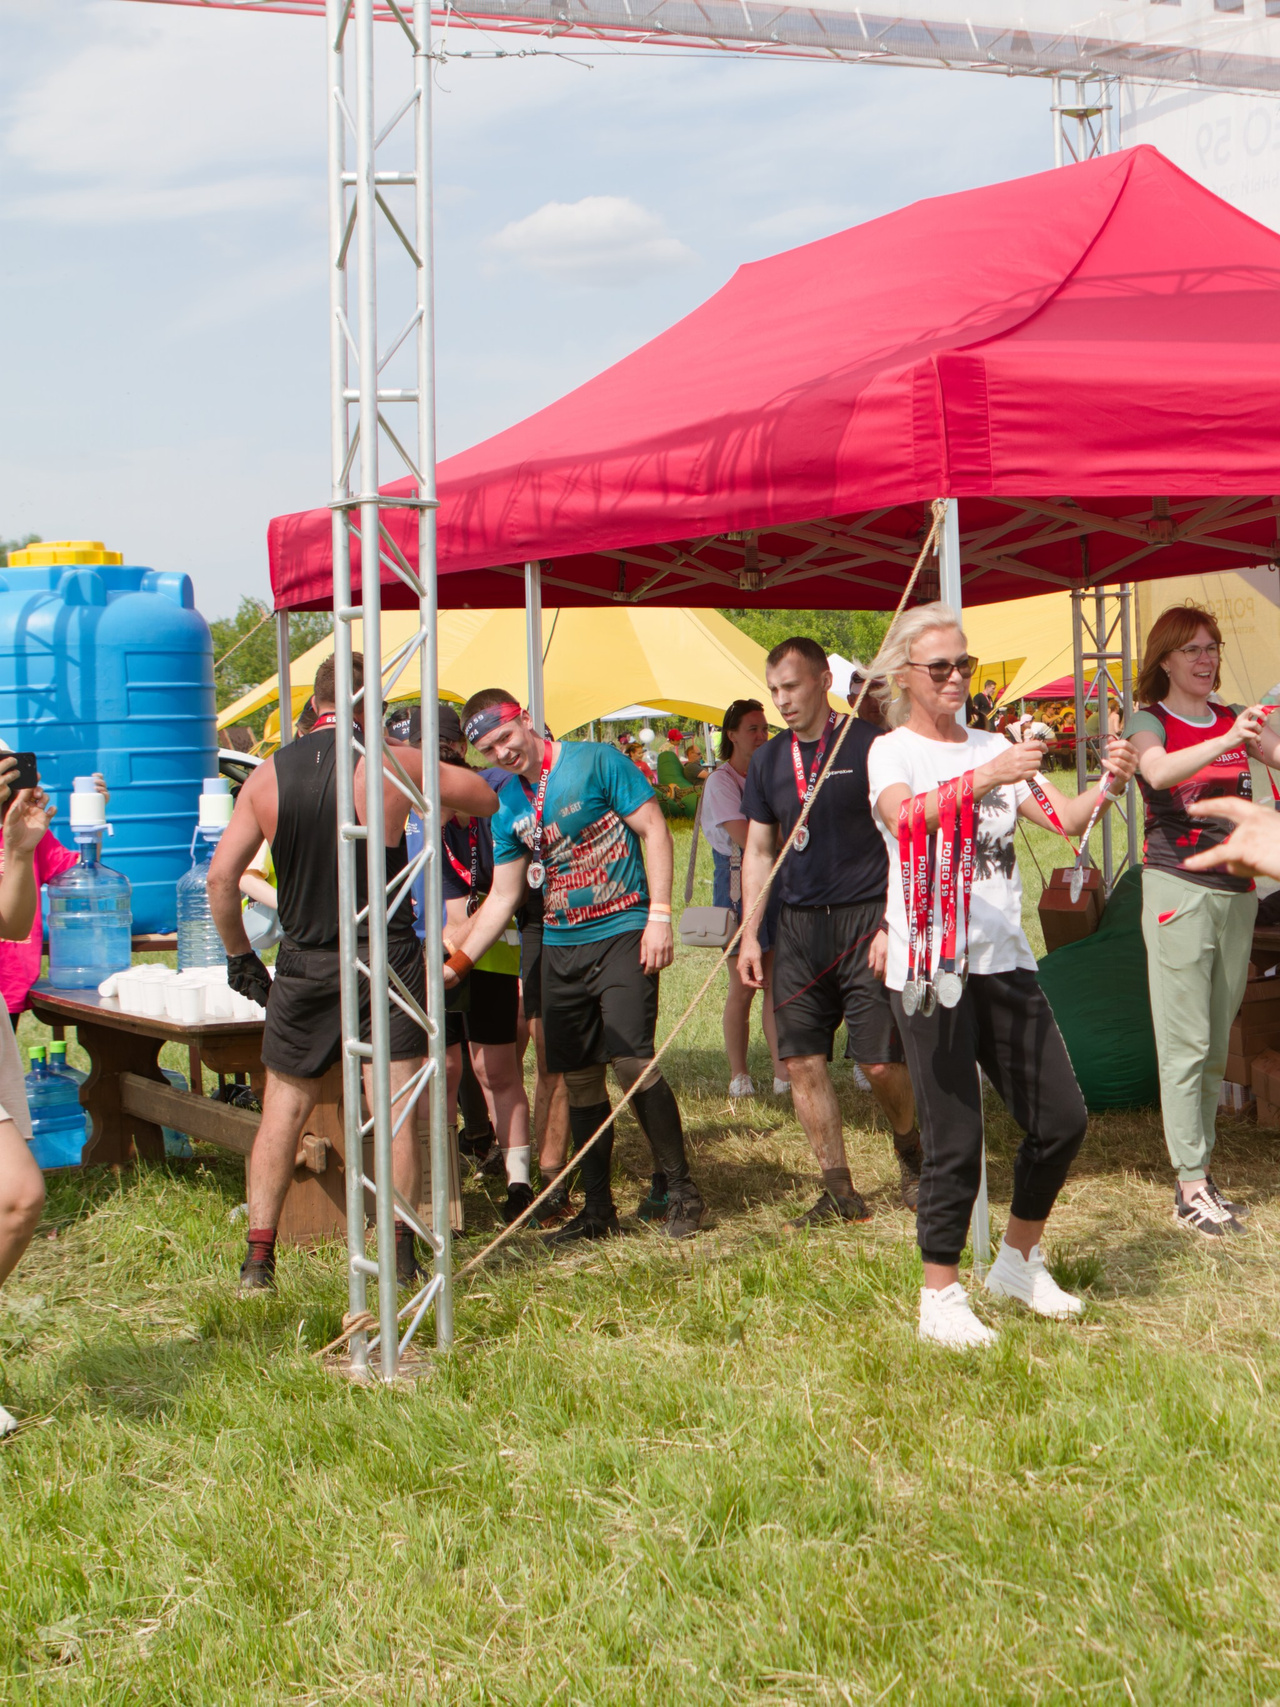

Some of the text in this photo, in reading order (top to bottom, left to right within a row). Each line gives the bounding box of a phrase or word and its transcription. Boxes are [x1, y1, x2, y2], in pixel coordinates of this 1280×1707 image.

[535, 769, 549, 799] РОДЕО
[1042, 801, 1055, 816] 59
[917, 855, 928, 895] РОДЕО
[942, 841, 953, 881] РОДЕО
[963, 838, 973, 878] РОДЕО
[902, 861, 911, 900] РОДЕО
[941, 884, 950, 897] 59
